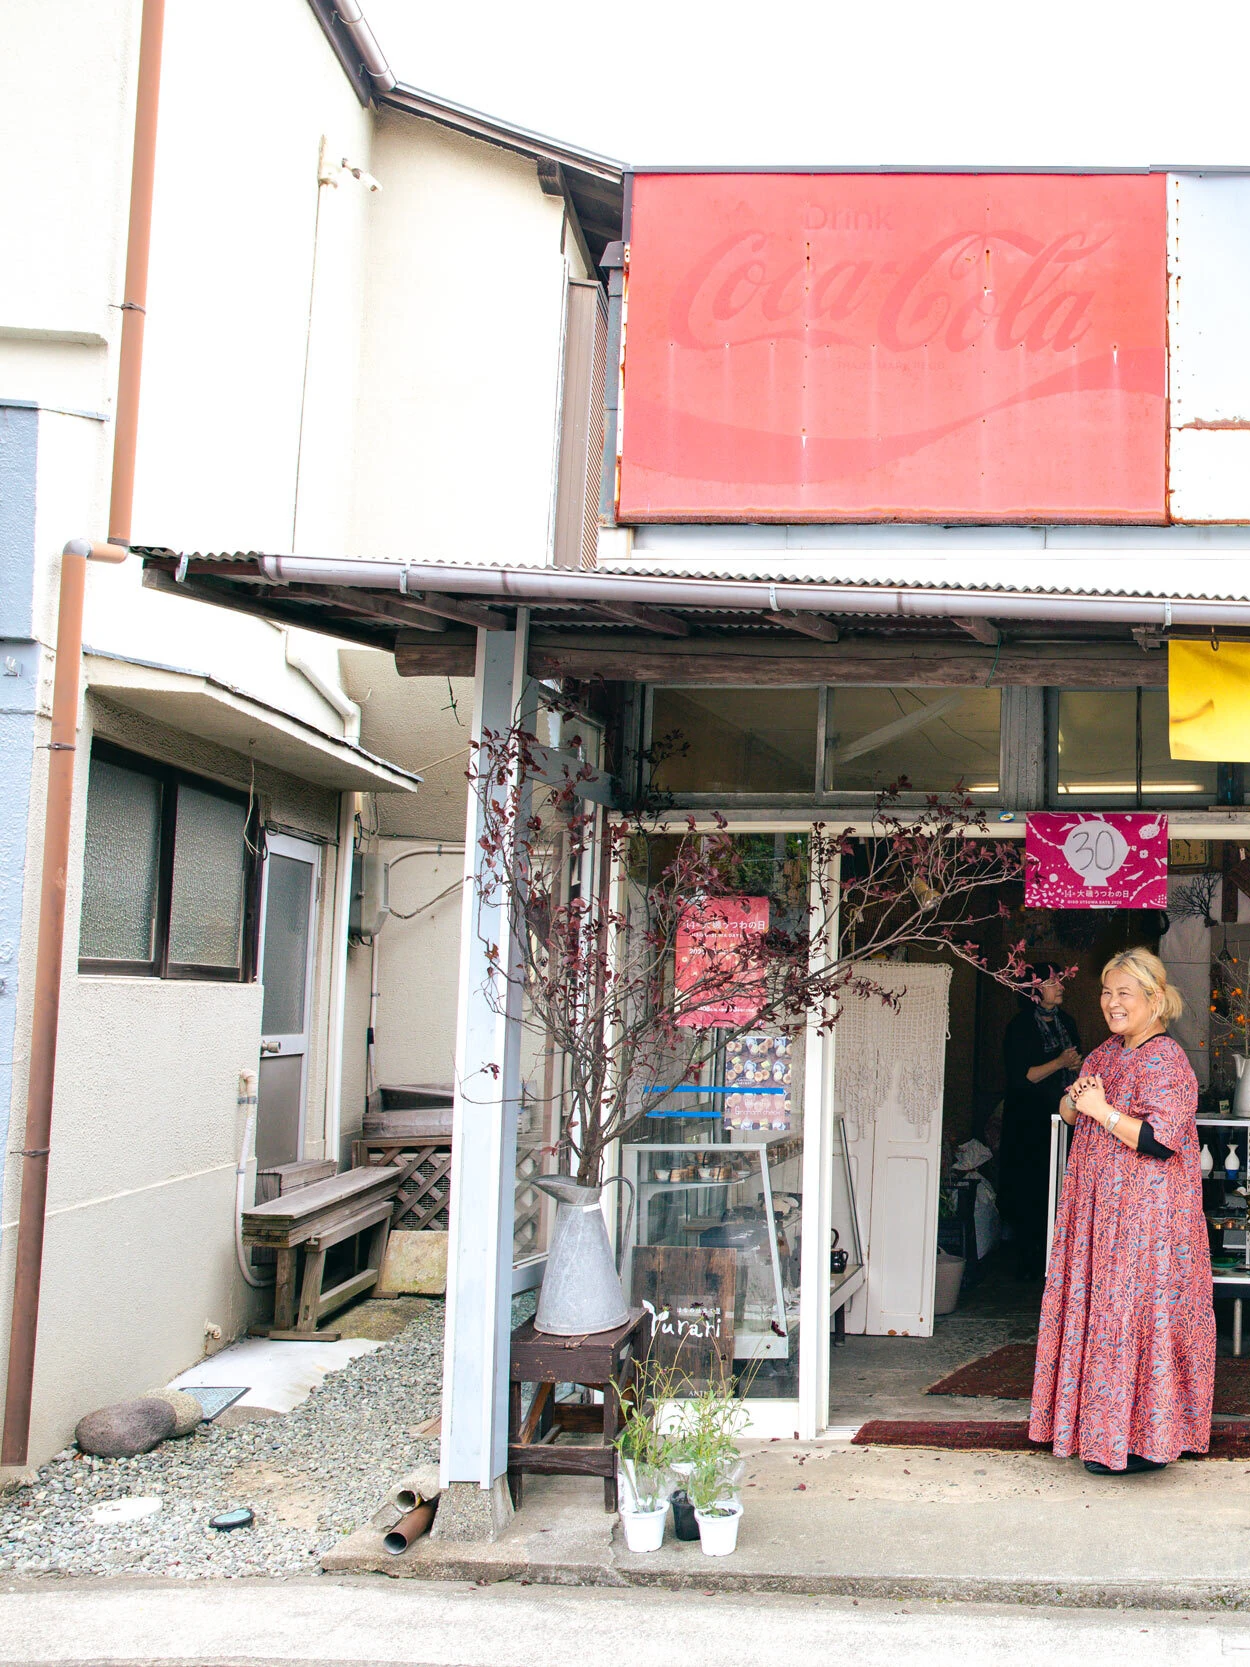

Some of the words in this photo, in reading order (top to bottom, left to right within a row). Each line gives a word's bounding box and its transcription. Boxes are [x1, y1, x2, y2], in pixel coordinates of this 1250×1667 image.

[804, 205, 895, 232] Drink
[668, 229, 1113, 353] Coca-Cola
[1073, 830, 1115, 871] 30
[642, 1299, 721, 1338] Yurari
